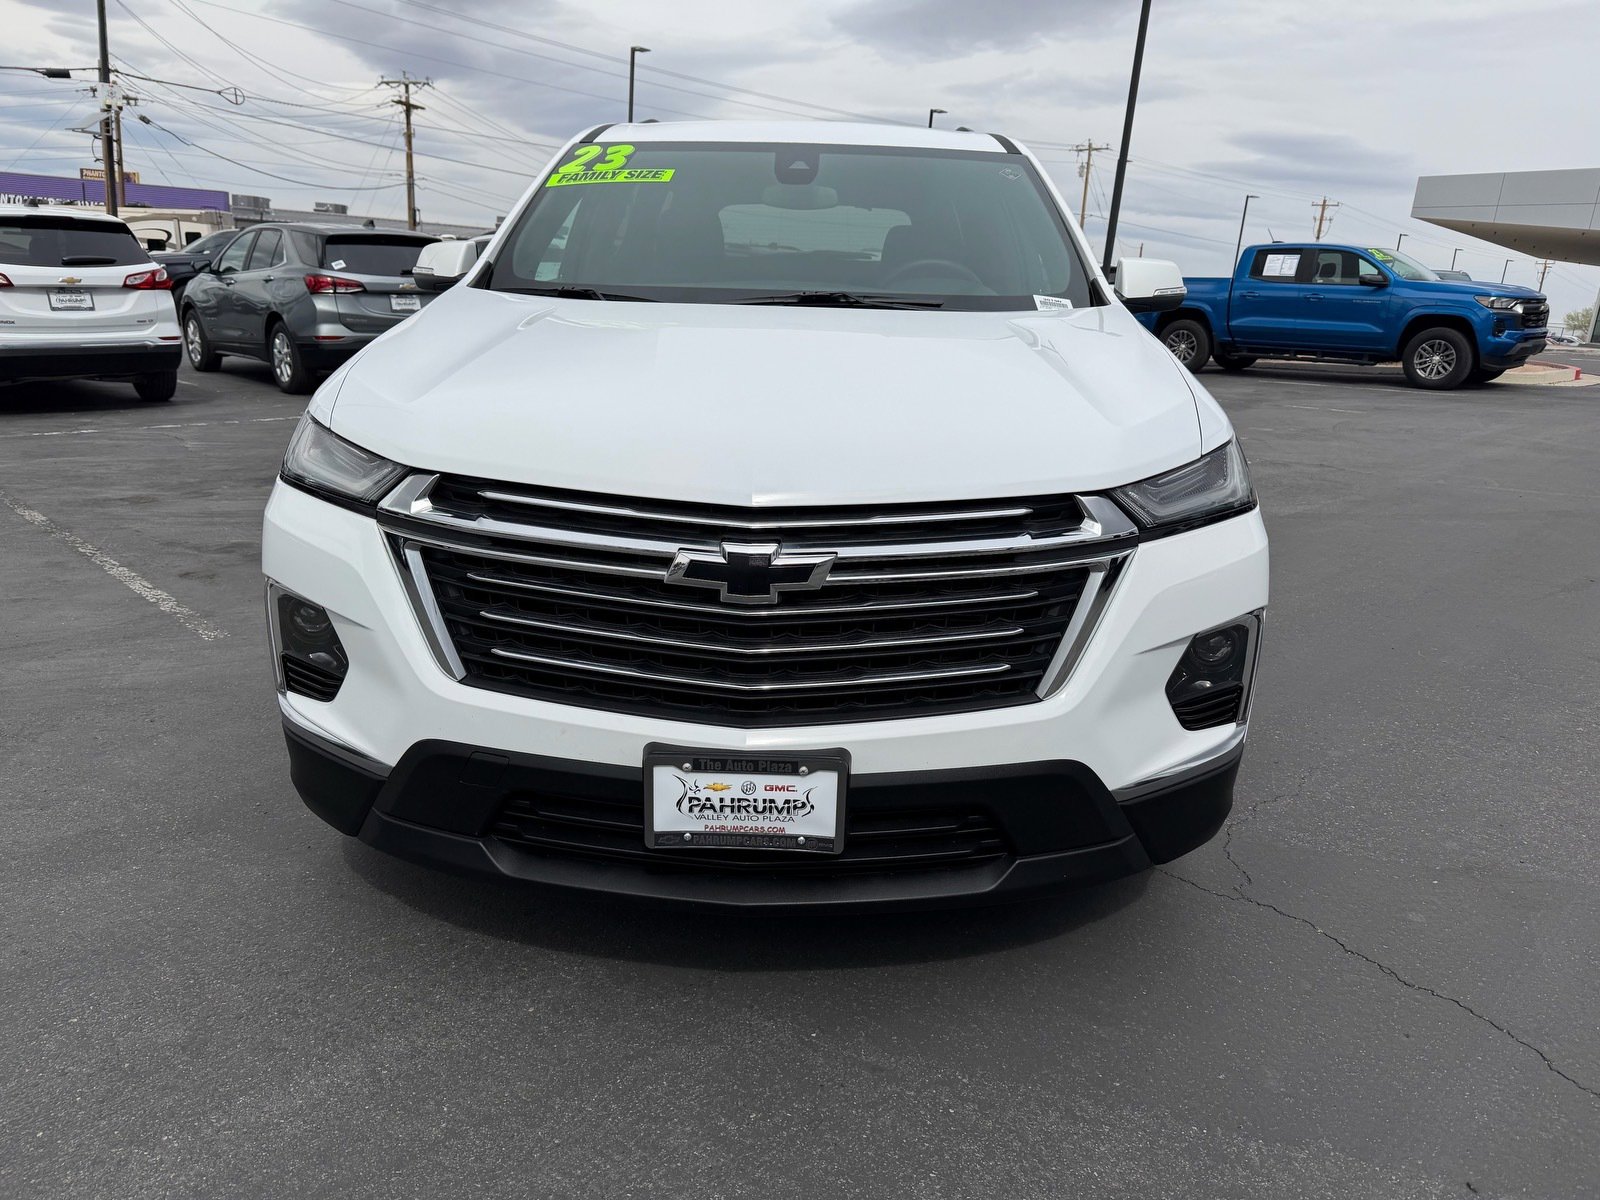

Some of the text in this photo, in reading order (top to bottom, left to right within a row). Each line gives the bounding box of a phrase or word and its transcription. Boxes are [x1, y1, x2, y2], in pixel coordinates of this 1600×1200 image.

[558, 144, 635, 173] 23
[82, 169, 106, 178] PHANTO
[557, 170, 666, 184] FAMILY SIZE
[699, 759, 793, 773] The Auto Plaza
[764, 784, 797, 793] GMC
[687, 796, 807, 817] PAHRUMP
[694, 813, 796, 823] VALLEY AUTO PLAZA
[704, 824, 786, 834] PAHRUMPCARS.COM
[693, 834, 797, 850] PAHRUMPCARS.COM
